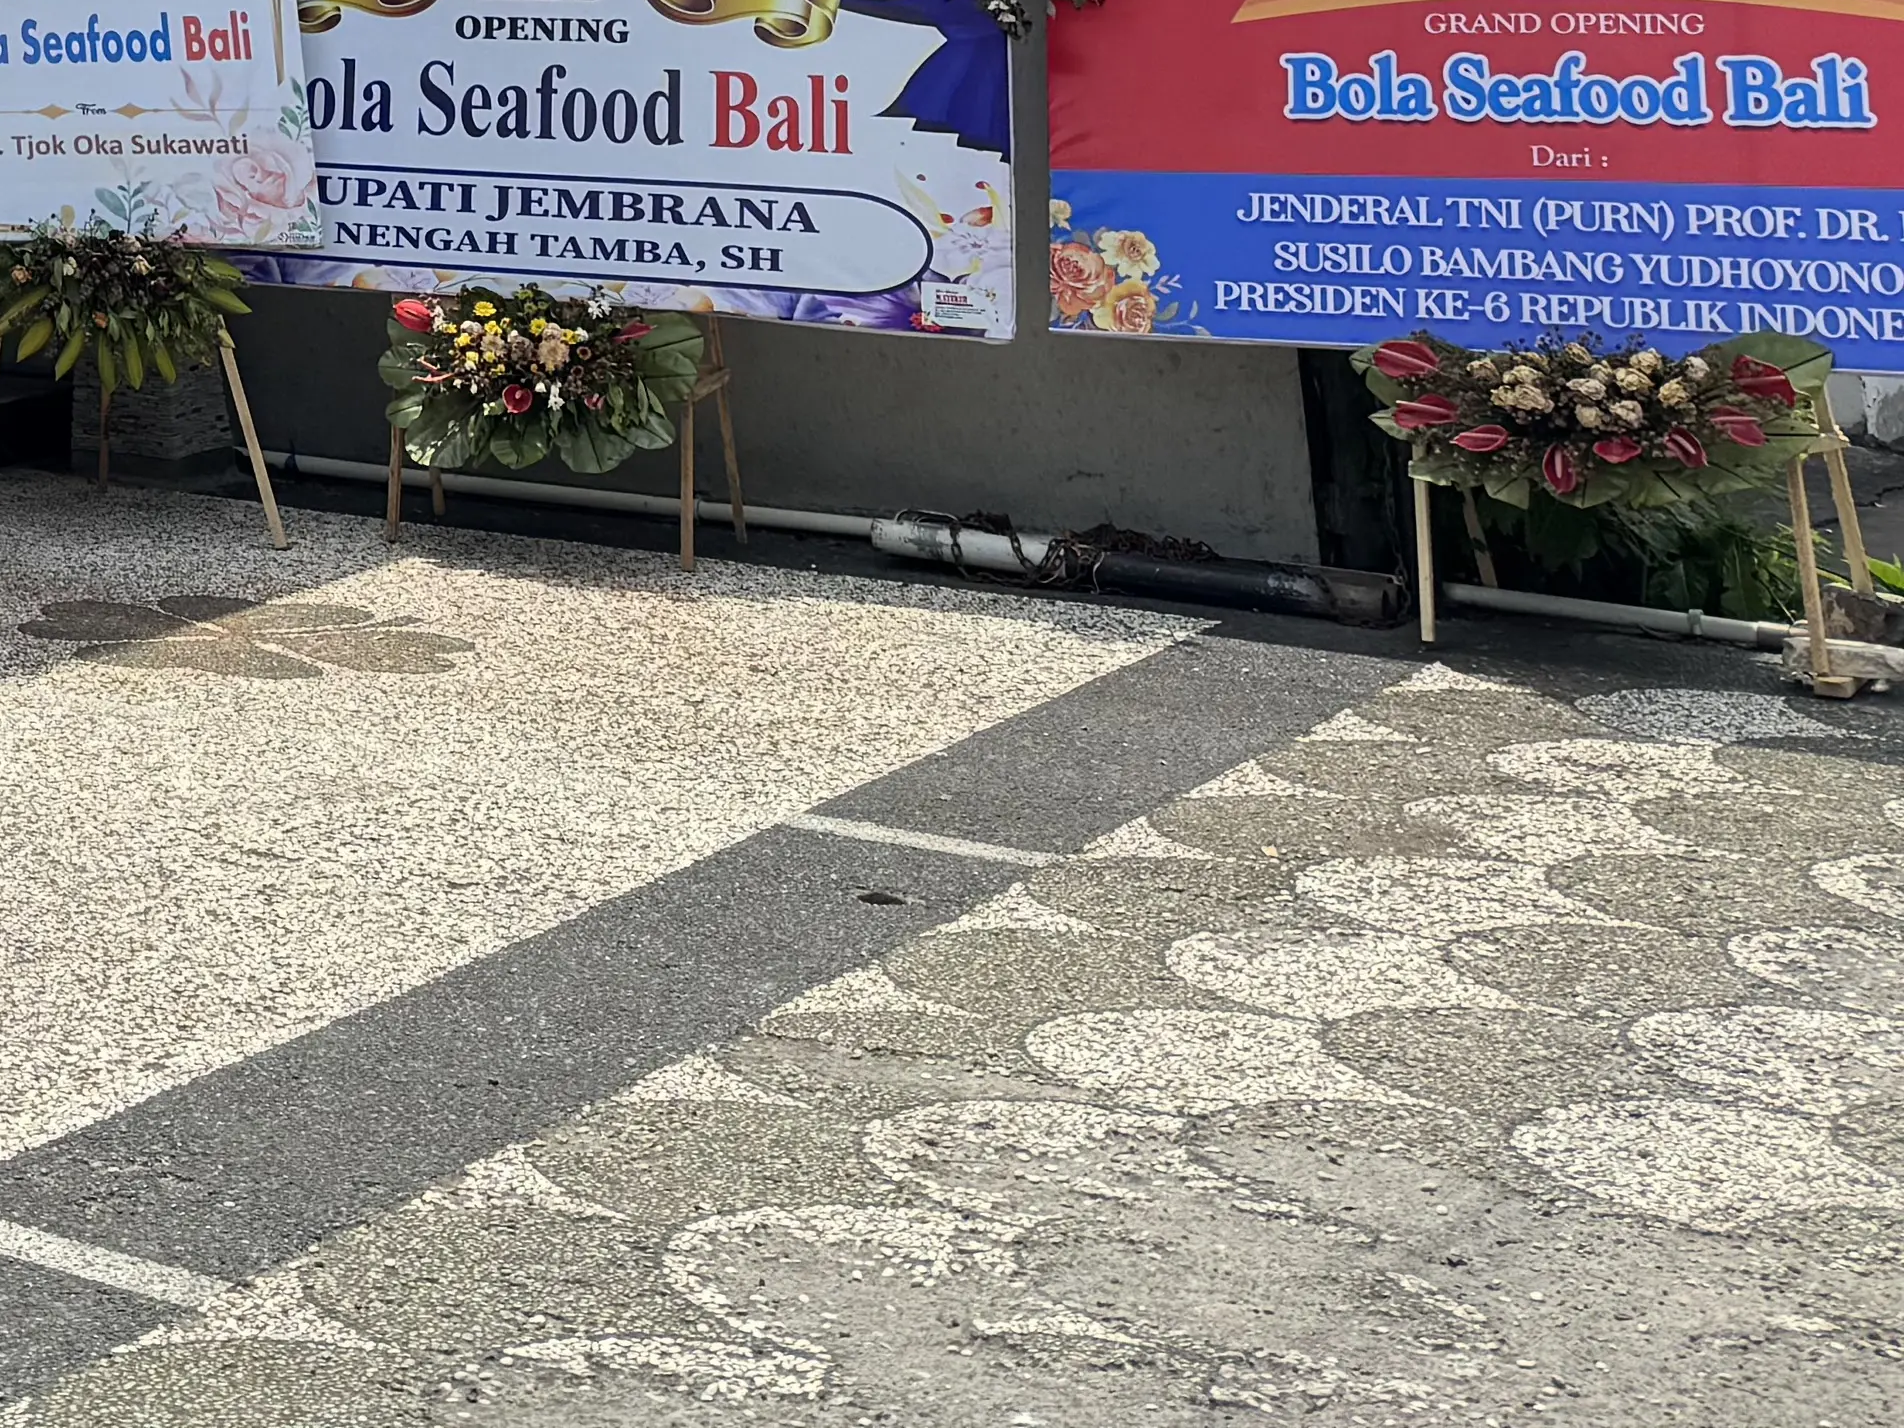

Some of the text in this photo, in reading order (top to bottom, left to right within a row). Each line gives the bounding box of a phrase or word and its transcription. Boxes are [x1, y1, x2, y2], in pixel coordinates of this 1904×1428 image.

[21, 11, 172, 64] Seafood
[182, 10, 252, 61] Bali
[454, 14, 630, 45] OPENING
[1423, 11, 1706, 37] GRAND OPENING
[306, 58, 853, 155] ola Seafood Bali
[1279, 48, 1878, 129] Bola Seafood Bali
[11, 133, 67, 161] Tjok
[73, 133, 124, 156] Oka
[131, 133, 249, 155] Sukawati
[317, 174, 820, 234] UPATI JEMBRANA
[1236, 192, 1444, 227] JENDERAL
[1445, 198, 1522, 230] TNI
[1532, 197, 1675, 243] (PURN)
[1683, 204, 1806, 238] PROF.
[1815, 208, 1889, 241] DR.
[334, 221, 518, 255] NENGAH
[530, 234, 706, 272] TAMBA,
[720, 243, 784, 273] SH
[1273, 242, 1904, 295] SUSILO BAMBANG YUDHOYONO
[1214, 281, 1408, 318] PRESIDEN
[1415, 290, 1510, 323] KE-6
[1520, 293, 1734, 334] REPUBLIK
